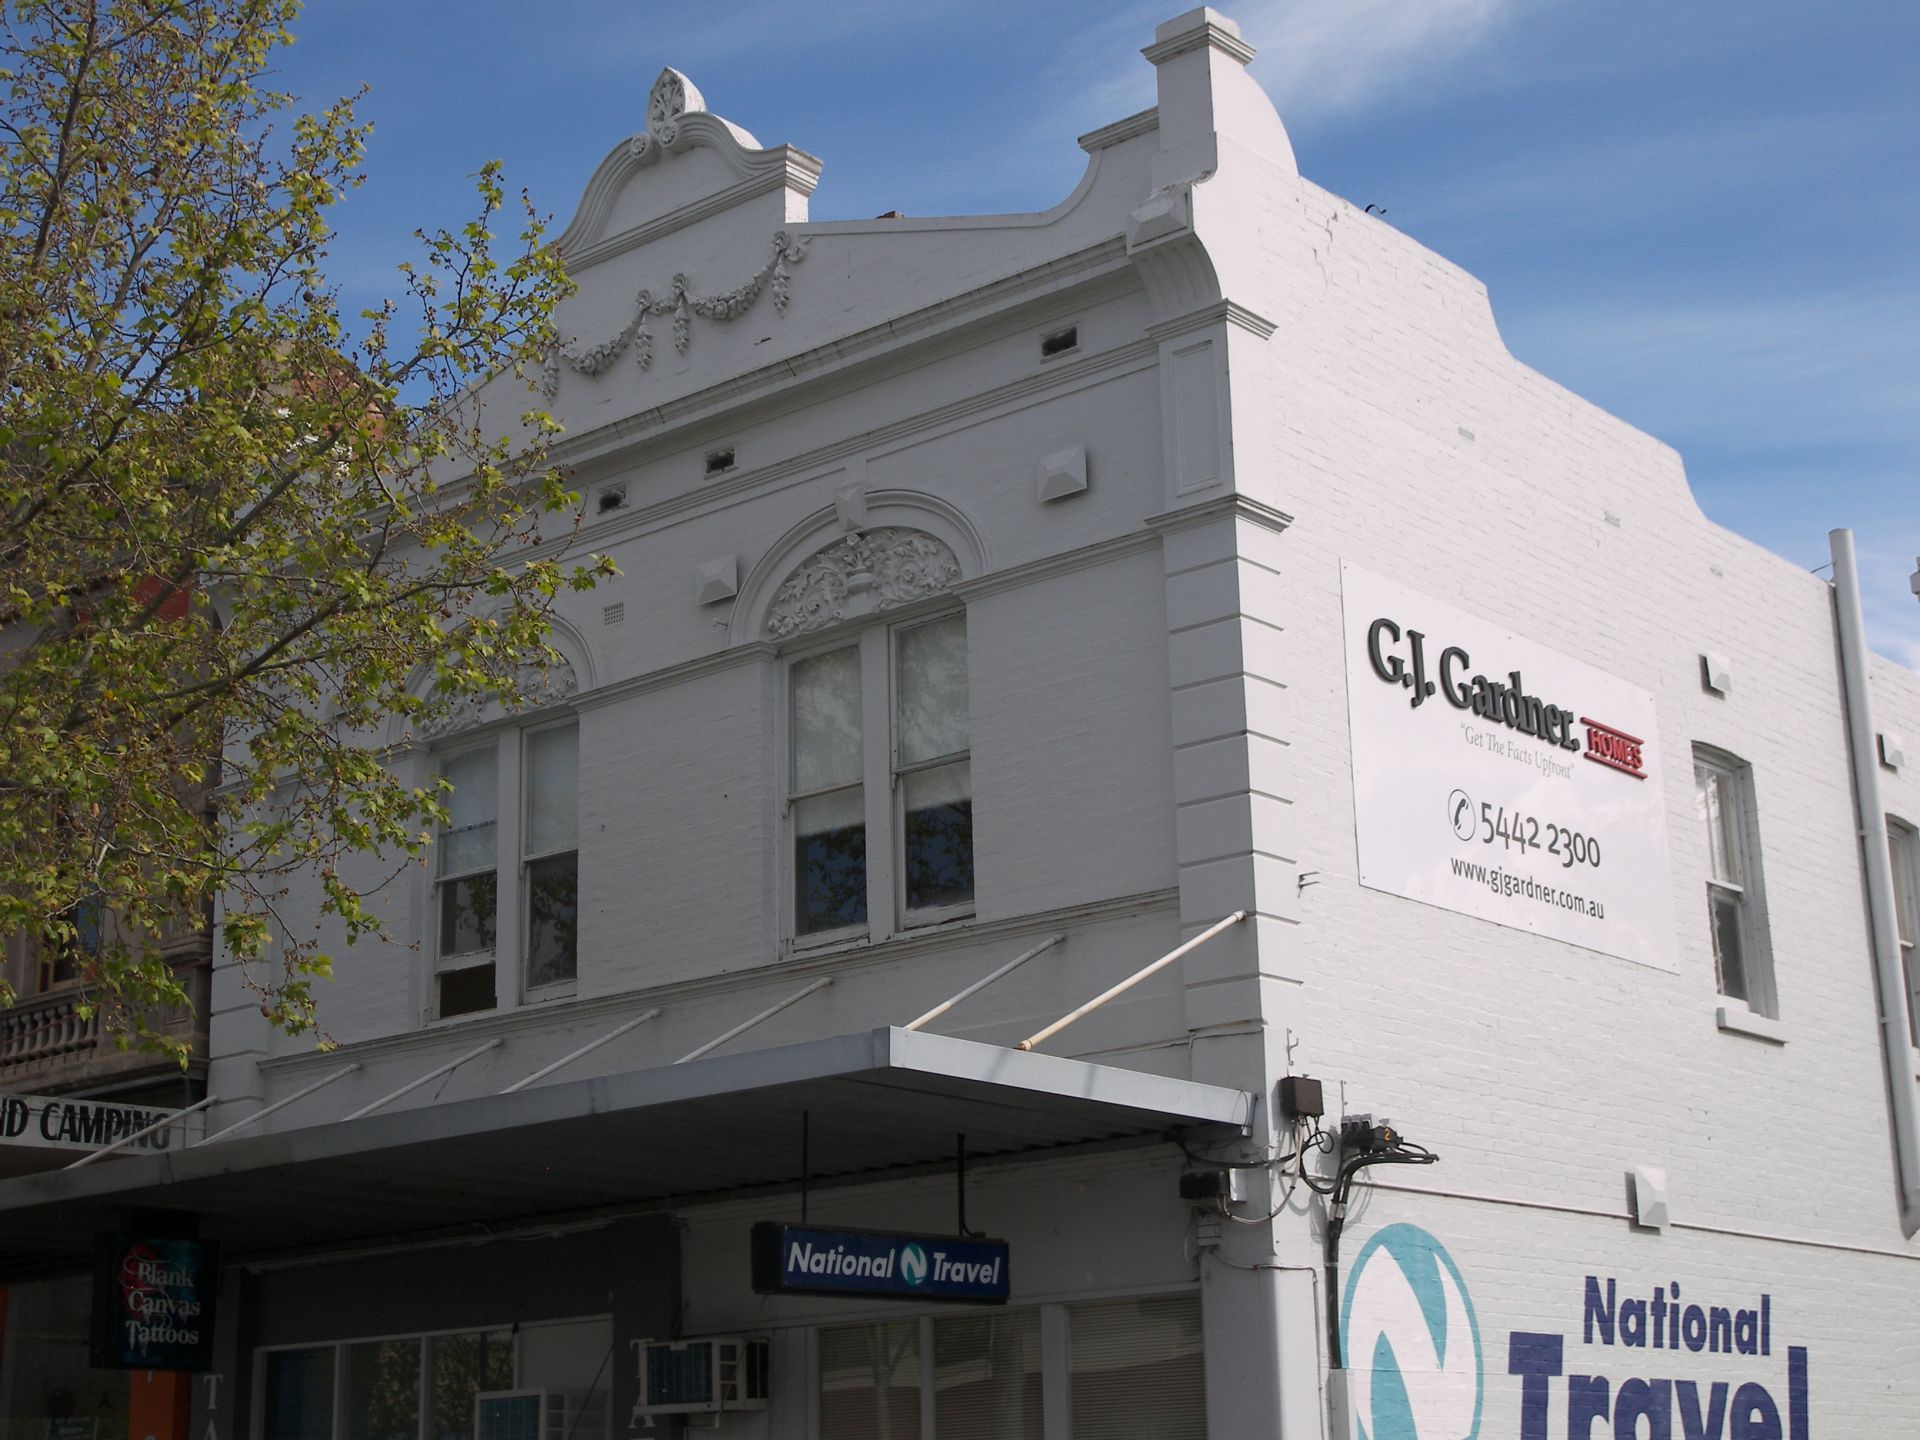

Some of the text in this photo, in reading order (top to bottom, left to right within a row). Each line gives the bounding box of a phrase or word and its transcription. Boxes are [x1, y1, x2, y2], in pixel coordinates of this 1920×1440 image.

[1367, 618, 1436, 708] G.J.
[1486, 733, 1506, 756] The
[1507, 741, 1533, 765] Facts
[1587, 728, 1642, 769] HOMES
[1481, 801, 1601, 868] 5442 2300
[1450, 857, 1604, 919] www.gjgardner.com.au
[0, 1098, 171, 1149] D CAMPING
[1383, 1126, 1392, 1142] 2
[138, 1261, 195, 1288] Blank
[787, 1242, 895, 1278] National
[932, 1252, 1000, 1284] Travel
[128, 1290, 201, 1322] Canvas
[1583, 1276, 1771, 1356] National
[125, 1320, 200, 1351] Tattoos
[1508, 1331, 1807, 1440] Travel
